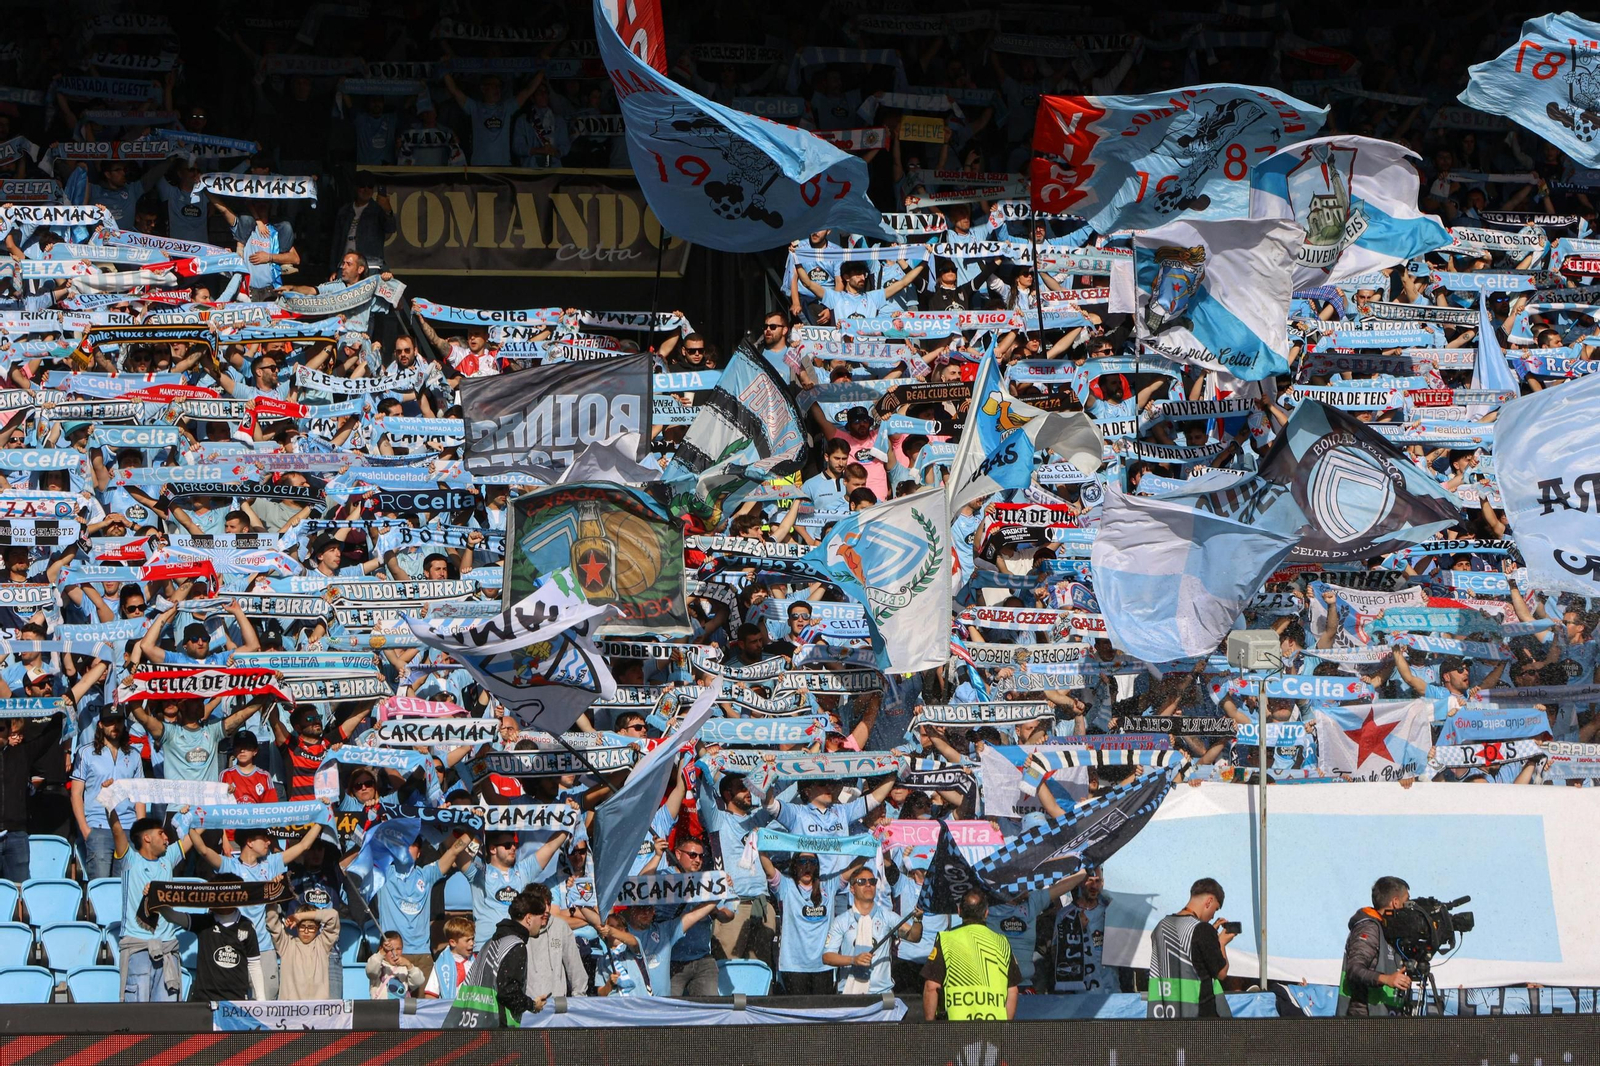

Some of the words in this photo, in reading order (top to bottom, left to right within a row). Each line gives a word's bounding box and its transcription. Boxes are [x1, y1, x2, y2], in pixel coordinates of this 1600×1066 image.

[57, 78, 109, 94] MAREXADA
[112, 79, 149, 96] CELESTE
[904, 122, 944, 139] BELIEVE
[64, 141, 108, 153] EURO
[120, 140, 170, 153] CELTA
[3, 183, 52, 194] CELTA
[70, 244, 120, 259] CELTA
[127, 248, 153, 260] RC
[555, 241, 642, 262] Celta
[217, 256, 243, 266] CELTA
[212, 307, 264, 326] CELTA
[958, 312, 972, 324] DE
[855, 319, 892, 330] IAGO
[904, 319, 950, 331] ASPAS
[826, 343, 891, 357] CELTA
[1217, 346, 1260, 370] Celta!
[159, 387, 193, 397] MANCHESTER
[906, 390, 926, 401] REAL
[928, 389, 947, 400] CLUB
[949, 387, 971, 398] CELTA
[1349, 392, 1363, 406] DE
[1364, 391, 1387, 406] TEIS
[1455, 392, 1496, 403] CELTA
[329, 402, 354, 411] CELTA
[1162, 402, 1216, 416] OLIVEIRA
[1219, 402, 1234, 413] DE
[890, 420, 913, 429] CELTA
[1380, 426, 1399, 435] VIGO
[1183, 447, 1197, 459] DE
[1200, 443, 1225, 457] TEIS
[1291, 546, 1330, 558] CELTA
[1421, 542, 1465, 551] CELTA
[343, 585, 398, 601] FUTBOL
[408, 585, 415, 597] E
[419, 581, 474, 597] BIRRAS
[811, 604, 855, 618] Celta
[830, 620, 870, 629] CELTA
[75, 629, 135, 642] CORAZÓN
[603, 643, 649, 657] JORGE
[269, 657, 318, 669] CELTA
[201, 677, 225, 691] DE
[388, 699, 449, 713] CELTA
[924, 707, 974, 721] UTBOL
[378, 721, 496, 742] CARCAMÄN
[492, 757, 549, 773] FUTBOL
[575, 754, 622, 770] BIRRAS
[212, 808, 220, 817] A
[222, 807, 249, 817] NOSA
[252, 803, 321, 815] RECONQUISTA
[157, 890, 187, 902] REAL
[188, 890, 216, 902] CLUB
[219, 890, 249, 902] CELTA
[222, 1005, 264, 1018] BAIXO
[266, 1004, 313, 1018] MINHO
